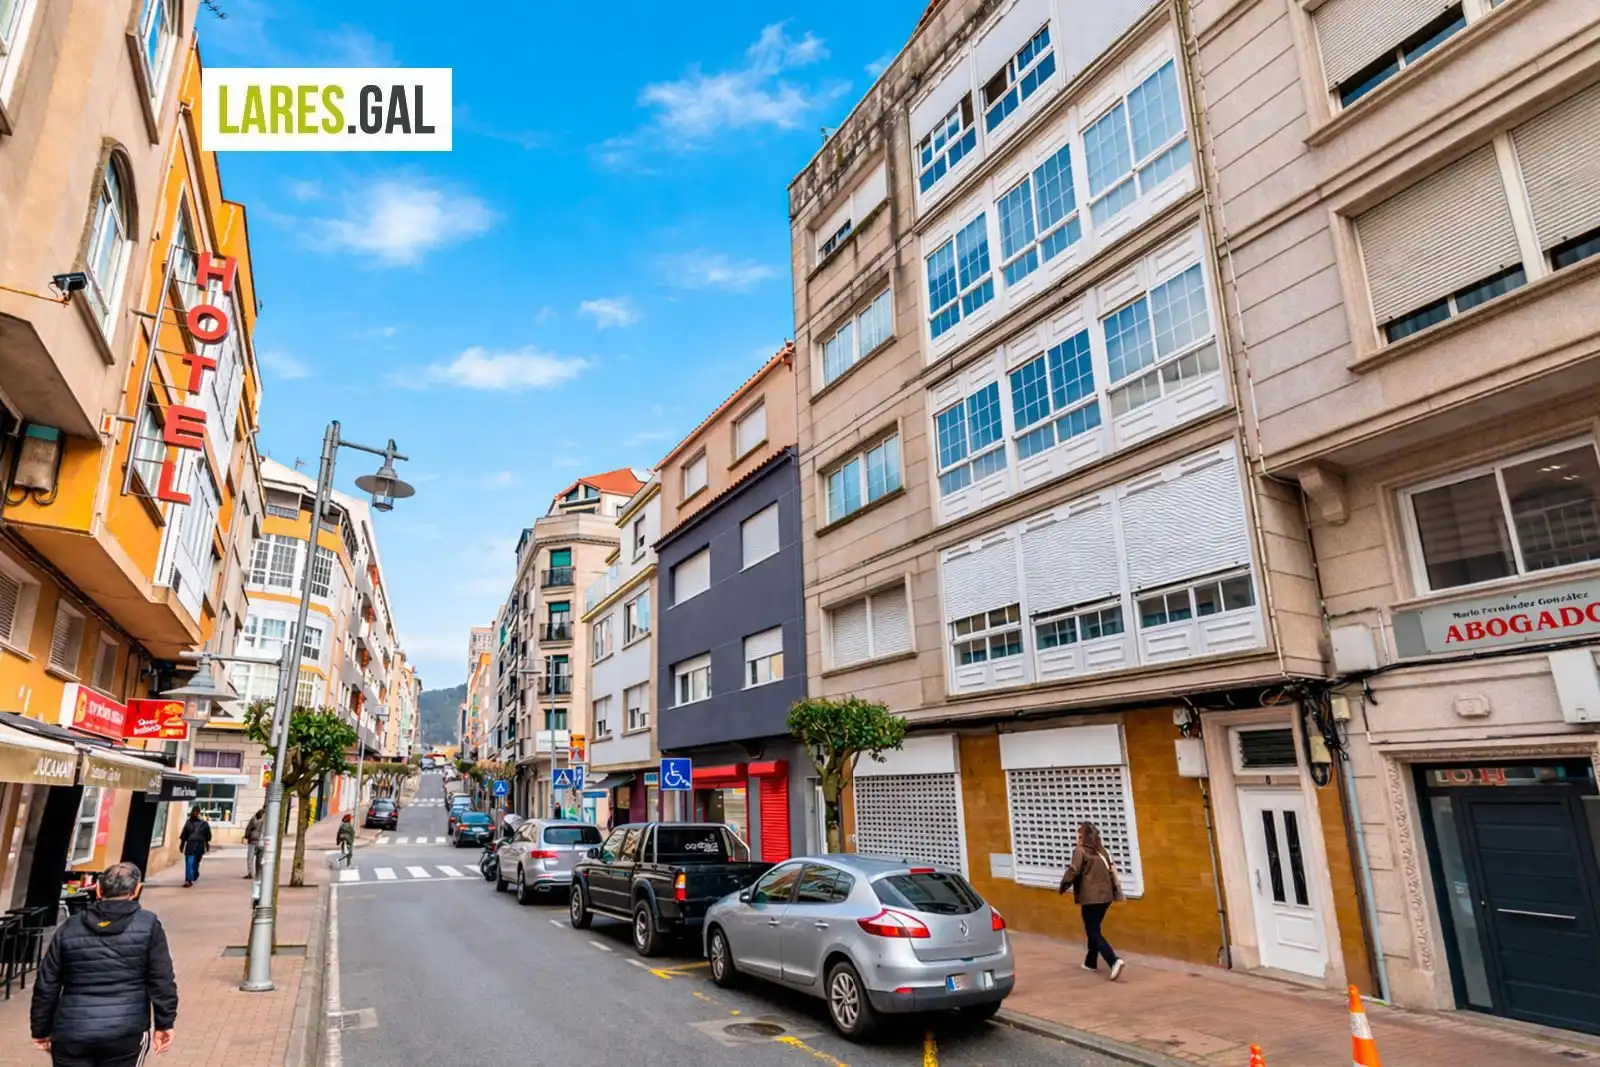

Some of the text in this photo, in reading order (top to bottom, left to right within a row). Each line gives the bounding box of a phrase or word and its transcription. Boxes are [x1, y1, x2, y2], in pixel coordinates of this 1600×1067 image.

[157, 251, 237, 506] HOTEL
[1481, 600, 1535, 615] Fernández
[1538, 592, 1589, 605] González
